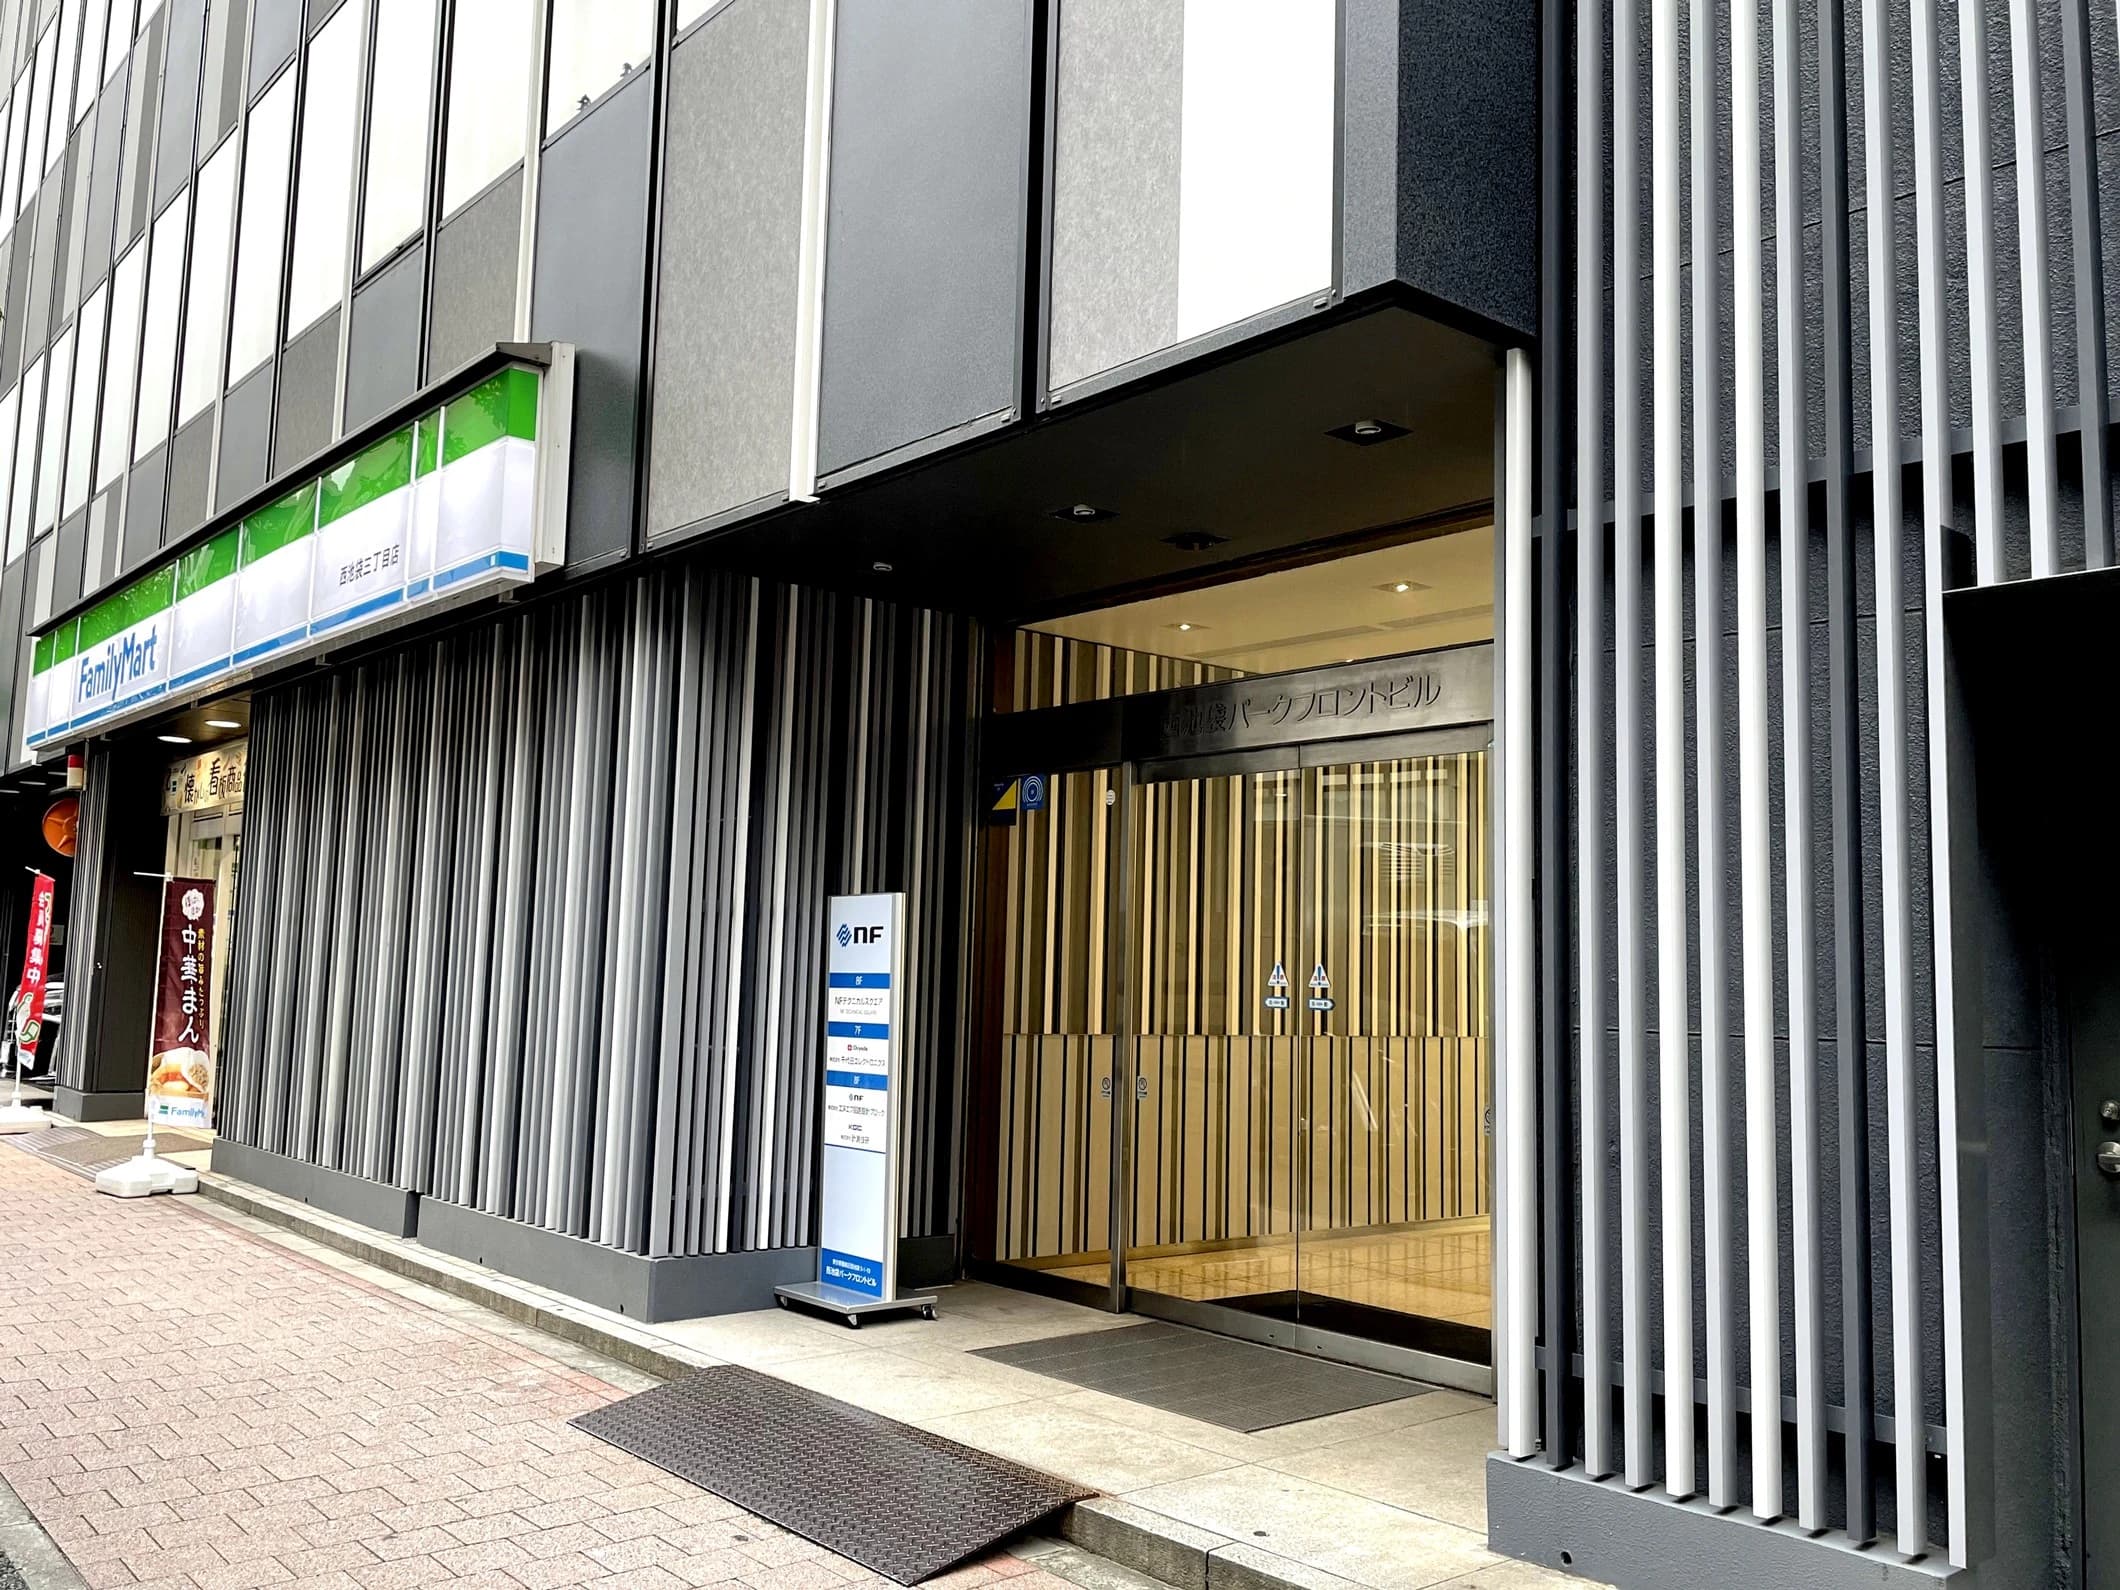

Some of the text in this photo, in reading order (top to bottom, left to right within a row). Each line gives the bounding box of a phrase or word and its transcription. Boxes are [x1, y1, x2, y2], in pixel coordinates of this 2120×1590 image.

[339, 544, 400, 586] 西池袋三丁目店
[78, 623, 158, 703] FamilyMart
[178, 923, 200, 1044] 中華まん
